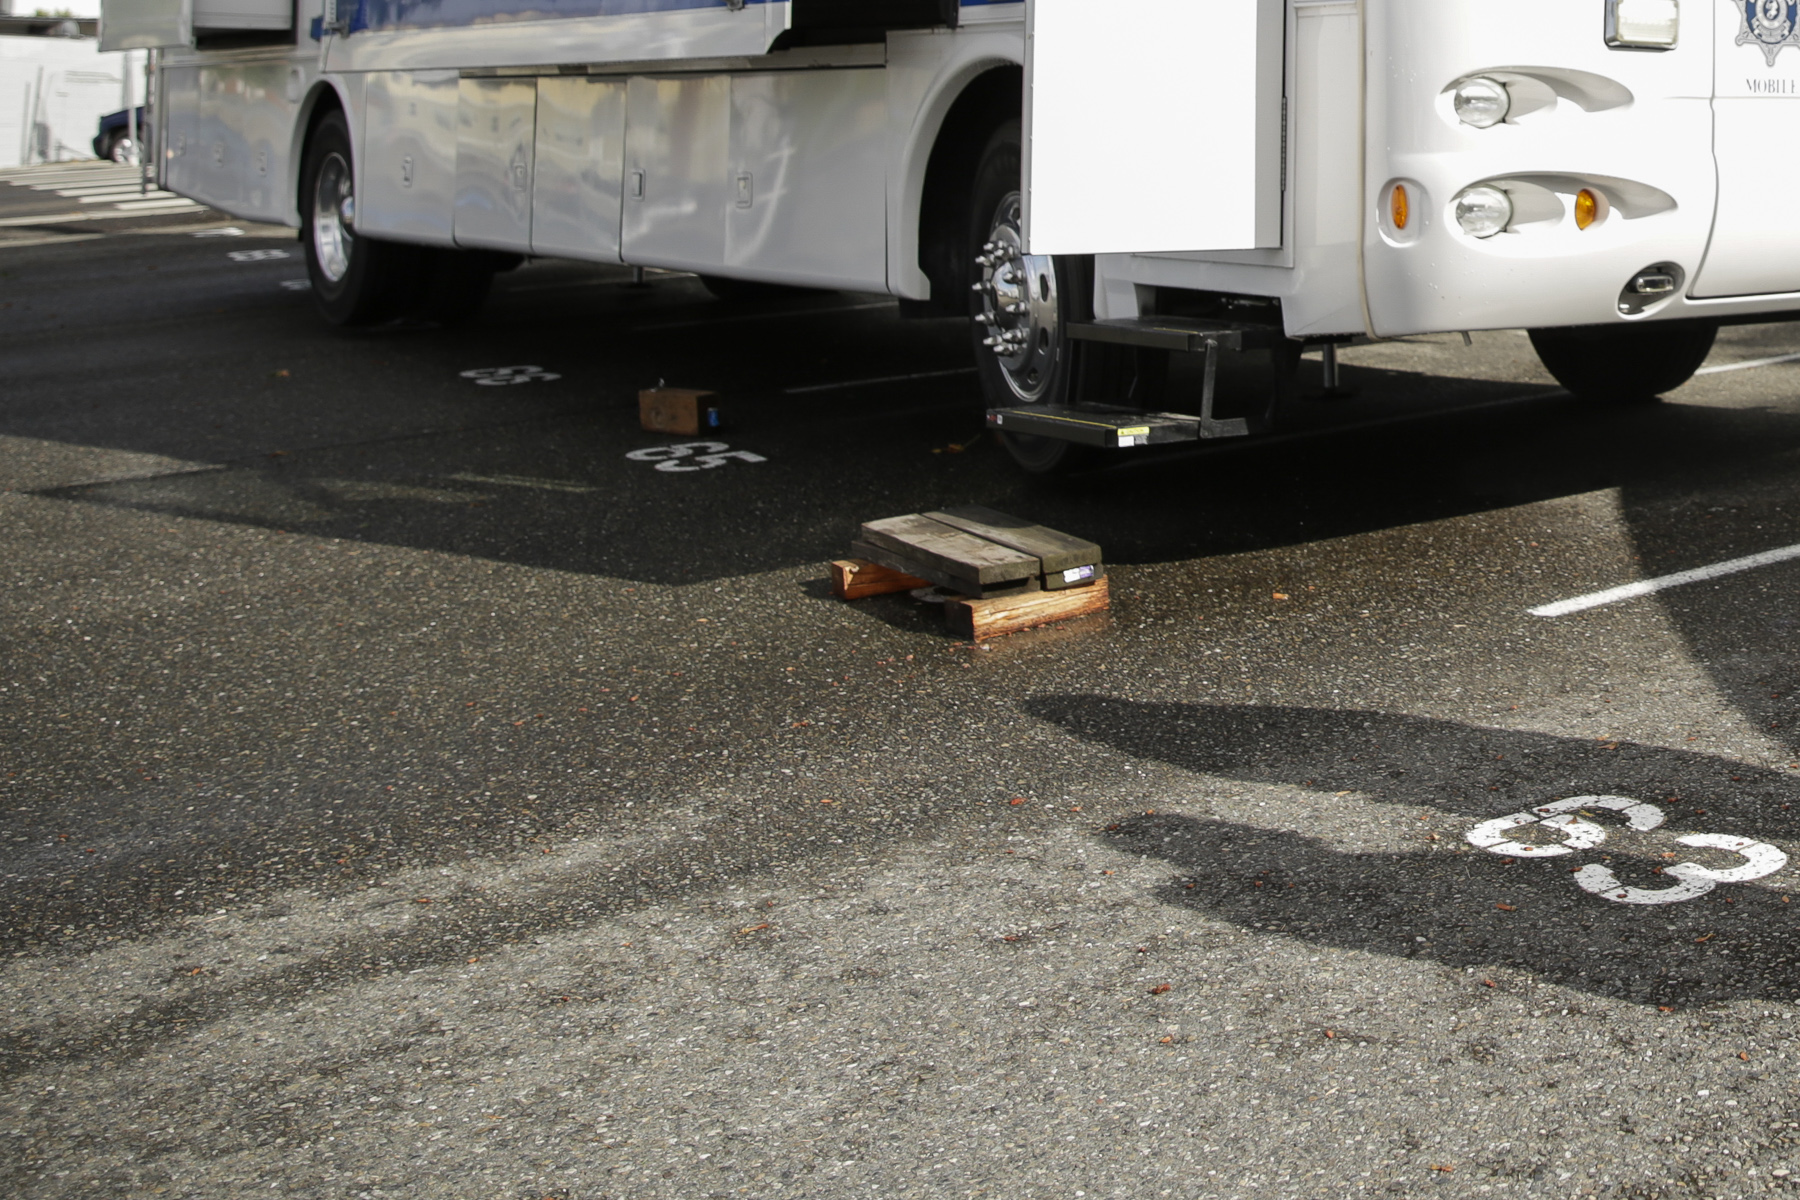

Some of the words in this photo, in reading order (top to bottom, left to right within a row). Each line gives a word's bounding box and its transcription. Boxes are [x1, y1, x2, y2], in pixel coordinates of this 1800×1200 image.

[1745, 78, 1798, 95] MOBILE
[625, 441, 768, 473] 65
[1465, 795, 1788, 905] 63
